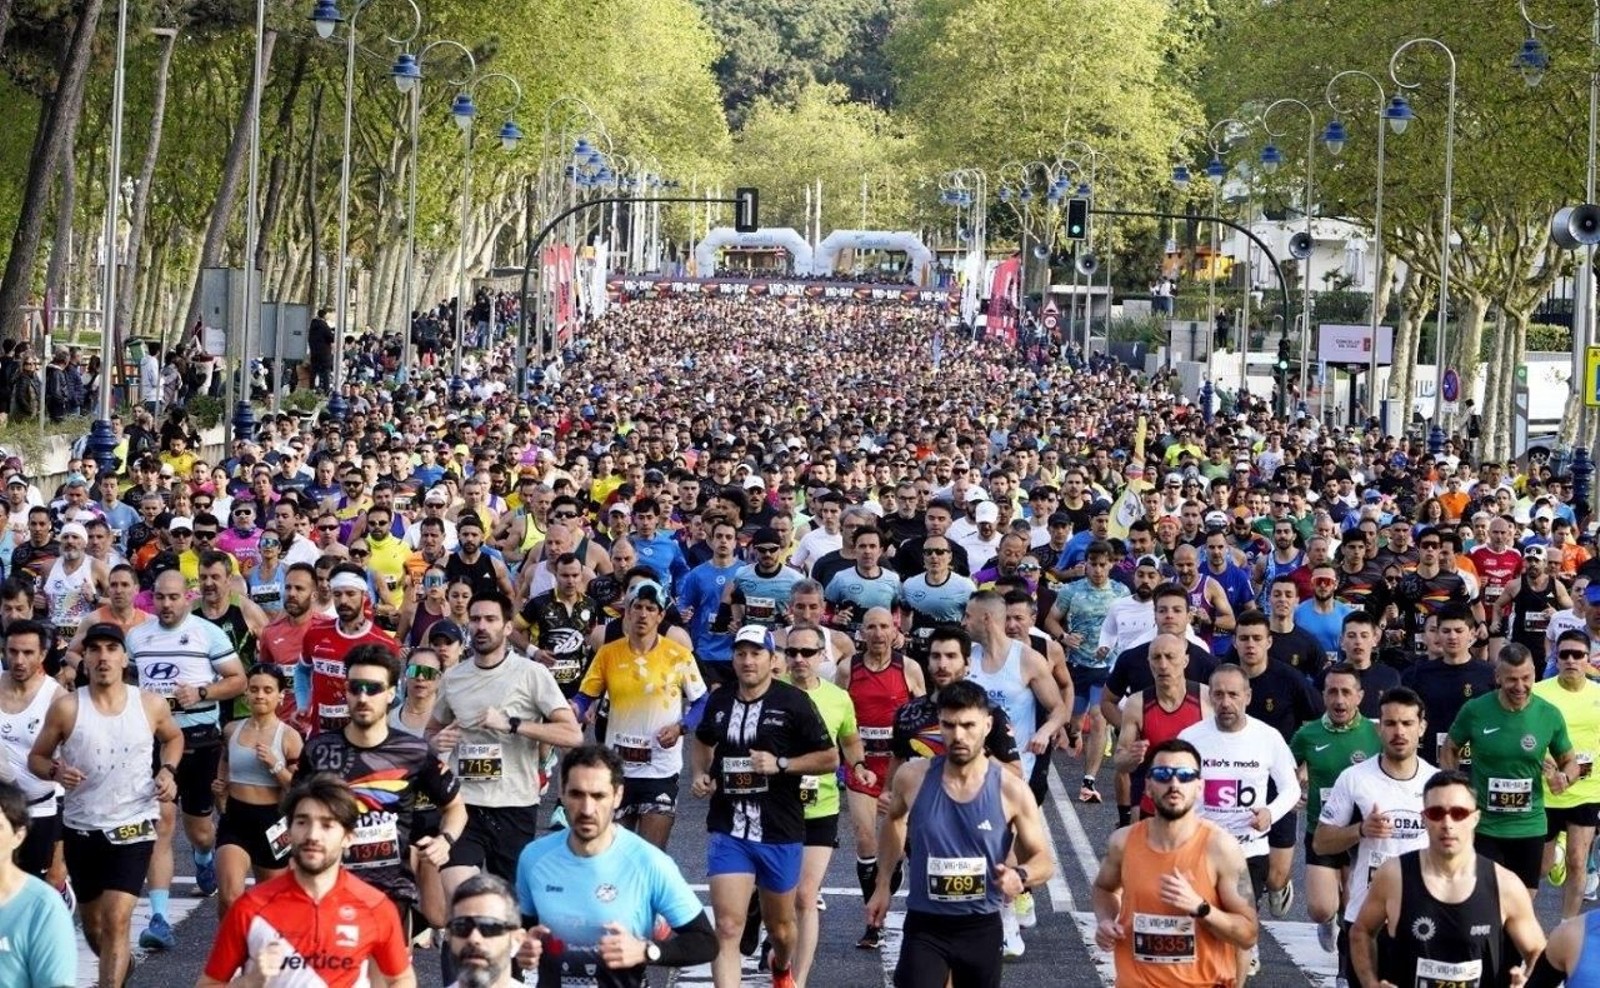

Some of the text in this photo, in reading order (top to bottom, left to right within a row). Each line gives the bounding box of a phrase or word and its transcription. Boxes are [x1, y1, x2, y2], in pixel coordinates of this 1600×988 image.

[860, 237, 891, 247] aqualia
[769, 283, 806, 297] VIG-BAY
[316, 744, 341, 770] 25
[1203, 758, 1260, 768] Kilo's moda
[468, 759, 492, 773] 715
[735, 772, 752, 786] 39
[1500, 793, 1525, 805] 912
[119, 822, 143, 839] 557
[351, 841, 392, 860] 1379
[943, 876, 974, 892] 769
[1149, 918, 1178, 928] VIG-BAY
[1146, 936, 1187, 952] 1335
